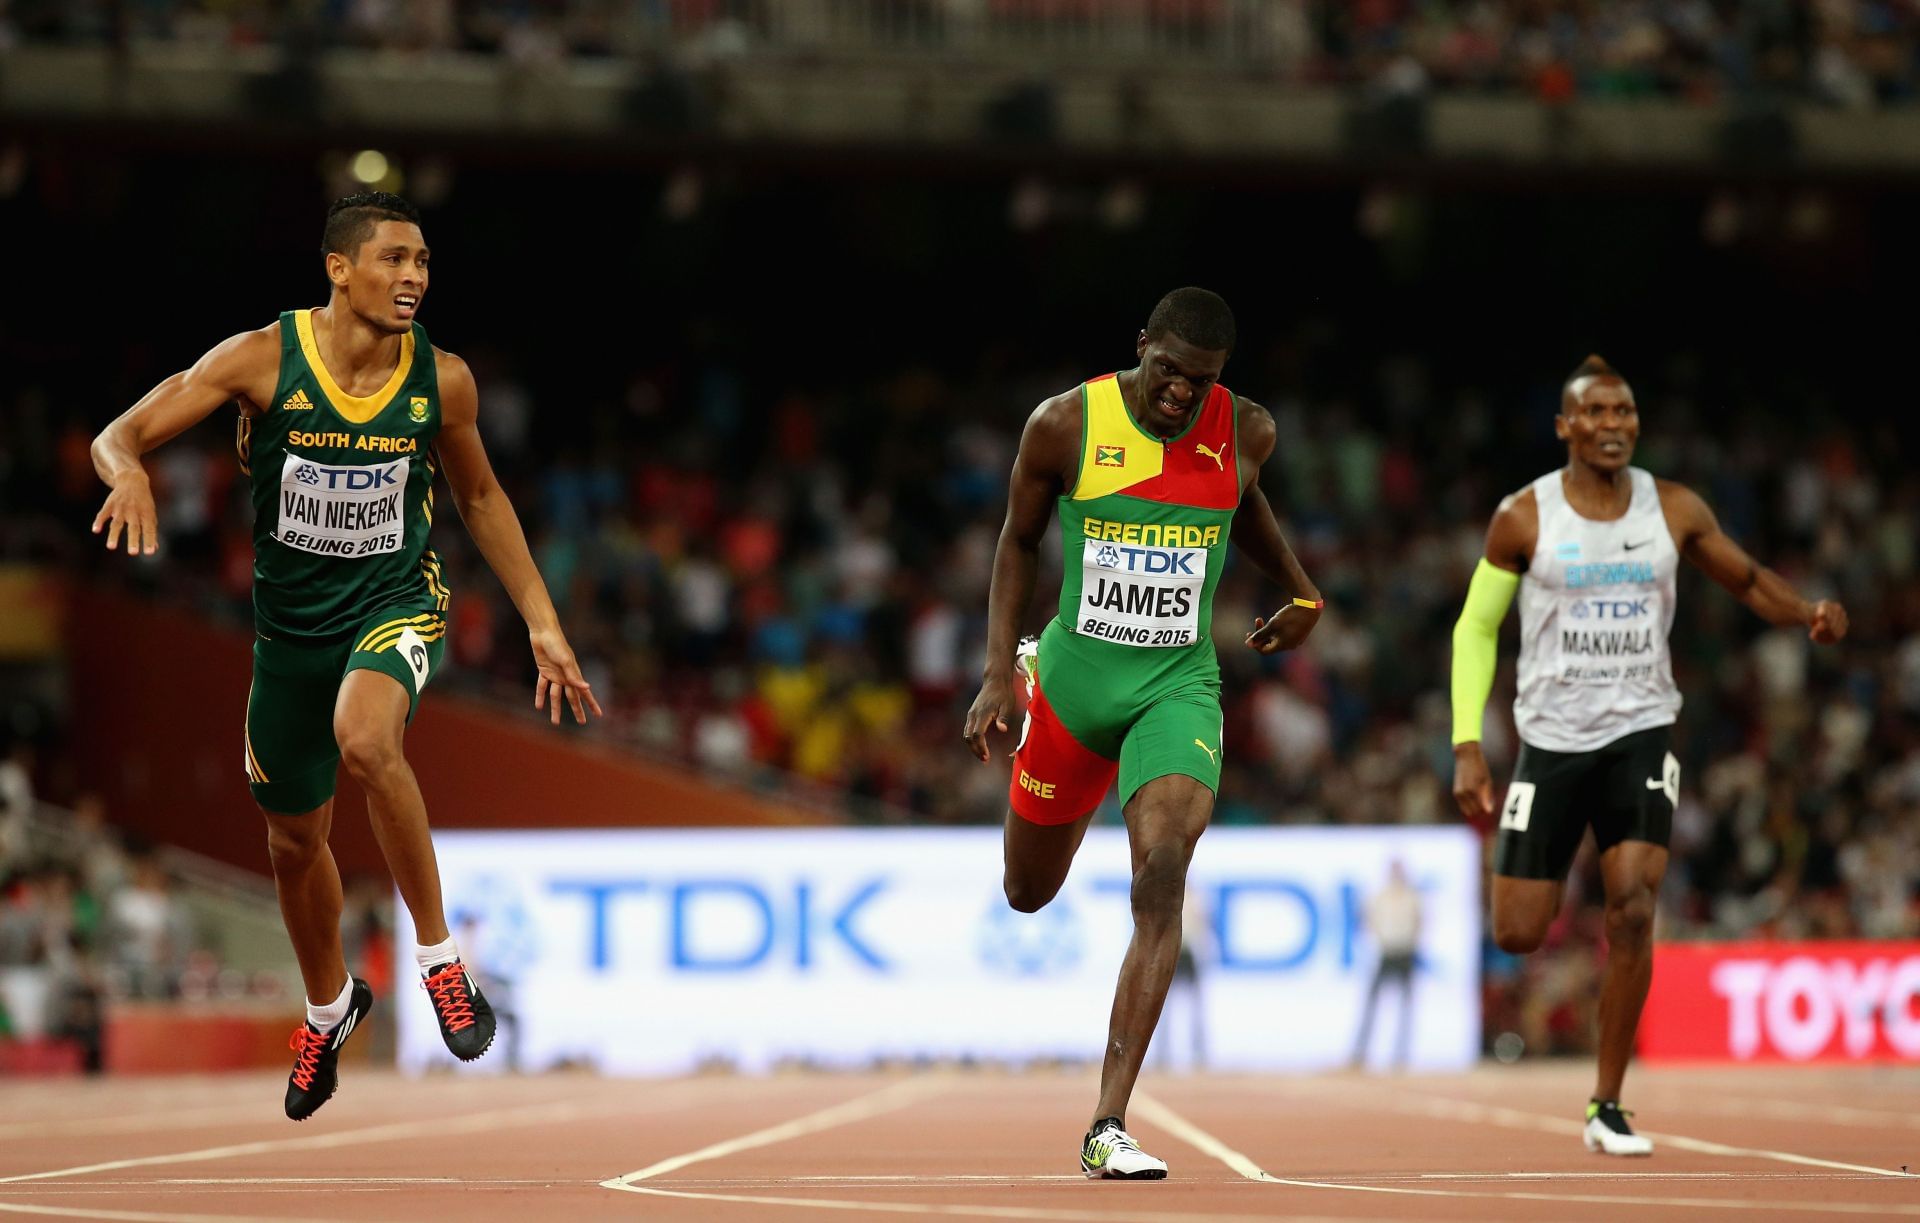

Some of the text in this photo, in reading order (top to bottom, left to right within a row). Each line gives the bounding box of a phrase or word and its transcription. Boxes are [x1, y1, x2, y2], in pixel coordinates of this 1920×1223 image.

[283, 401, 314, 410] adidas
[288, 431, 417, 453] SOUTH AFRICA
[319, 464, 399, 490] TDK
[283, 491, 399, 531] VAN NIEKERK
[283, 530, 397, 555] BEIJING 2015
[1083, 517, 1221, 548] GRENADA
[1119, 547, 1196, 575] TDK
[1087, 578, 1192, 618] JAMES
[1591, 598, 1650, 619] TDK
[1083, 618, 1191, 645] BEIJING 2015
[1562, 629, 1654, 656] MAKWALA
[410, 645, 426, 673] 6
[1018, 769, 1057, 799] GRE
[1507, 792, 1521, 822] 4
[547, 875, 894, 972] TDK
